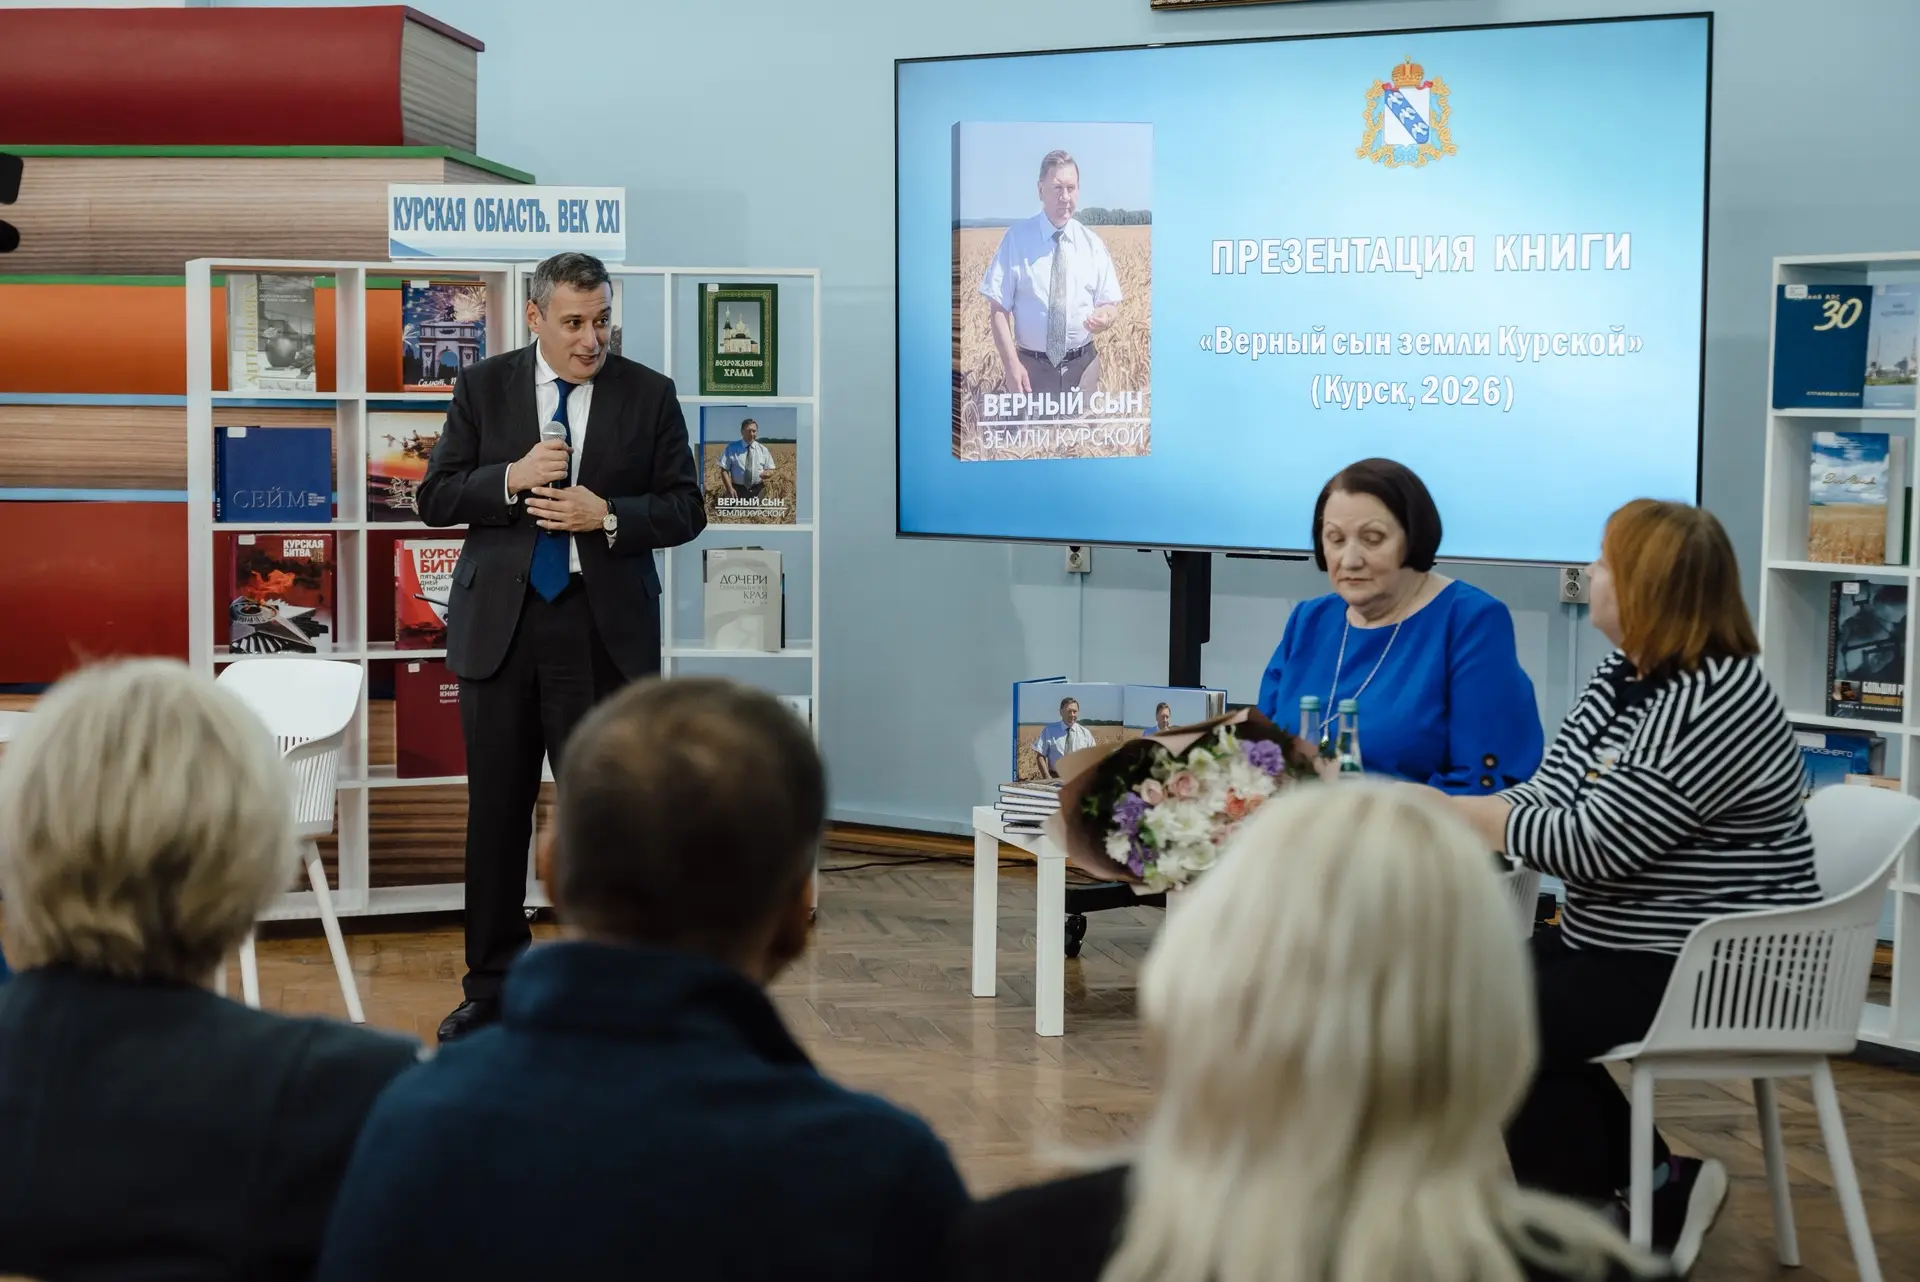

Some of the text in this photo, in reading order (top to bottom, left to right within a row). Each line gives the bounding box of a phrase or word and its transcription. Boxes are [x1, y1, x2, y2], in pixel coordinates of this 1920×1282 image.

[393, 197, 466, 231] КУРСКАЯ
[474, 198, 550, 232] ОБЛАСТЬ.
[558, 199, 589, 233] ВЕК
[1212, 232, 1632, 279] ПРЕЗЕНТАЦИЯ КНИГИ
[1813, 298, 1863, 331] 30
[1199, 325, 1644, 362] «Верный сын земли Курской»
[724, 369, 754, 377] ХРАМА
[1310, 374, 1515, 412] (Курск, 2026)
[983, 386, 1143, 417] ВЕРНЫЙ СЫН
[983, 424, 1144, 449] ЗЕМЛИ КУРСКОЙ
[233, 486, 307, 508] СЕЙМ
[717, 496, 785, 506] ВЕРНЫЙ СЫН
[748, 509, 785, 517] КУРСКОЙ
[283, 539, 324, 549] КУРСКАЯ
[283, 548, 312, 557] БИТВА
[420, 548, 461, 559] КУРСК
[420, 560, 455, 573] БИТ
[720, 574, 768, 584] ДОЧЕРИ
[743, 591, 768, 599] КРАЯ
